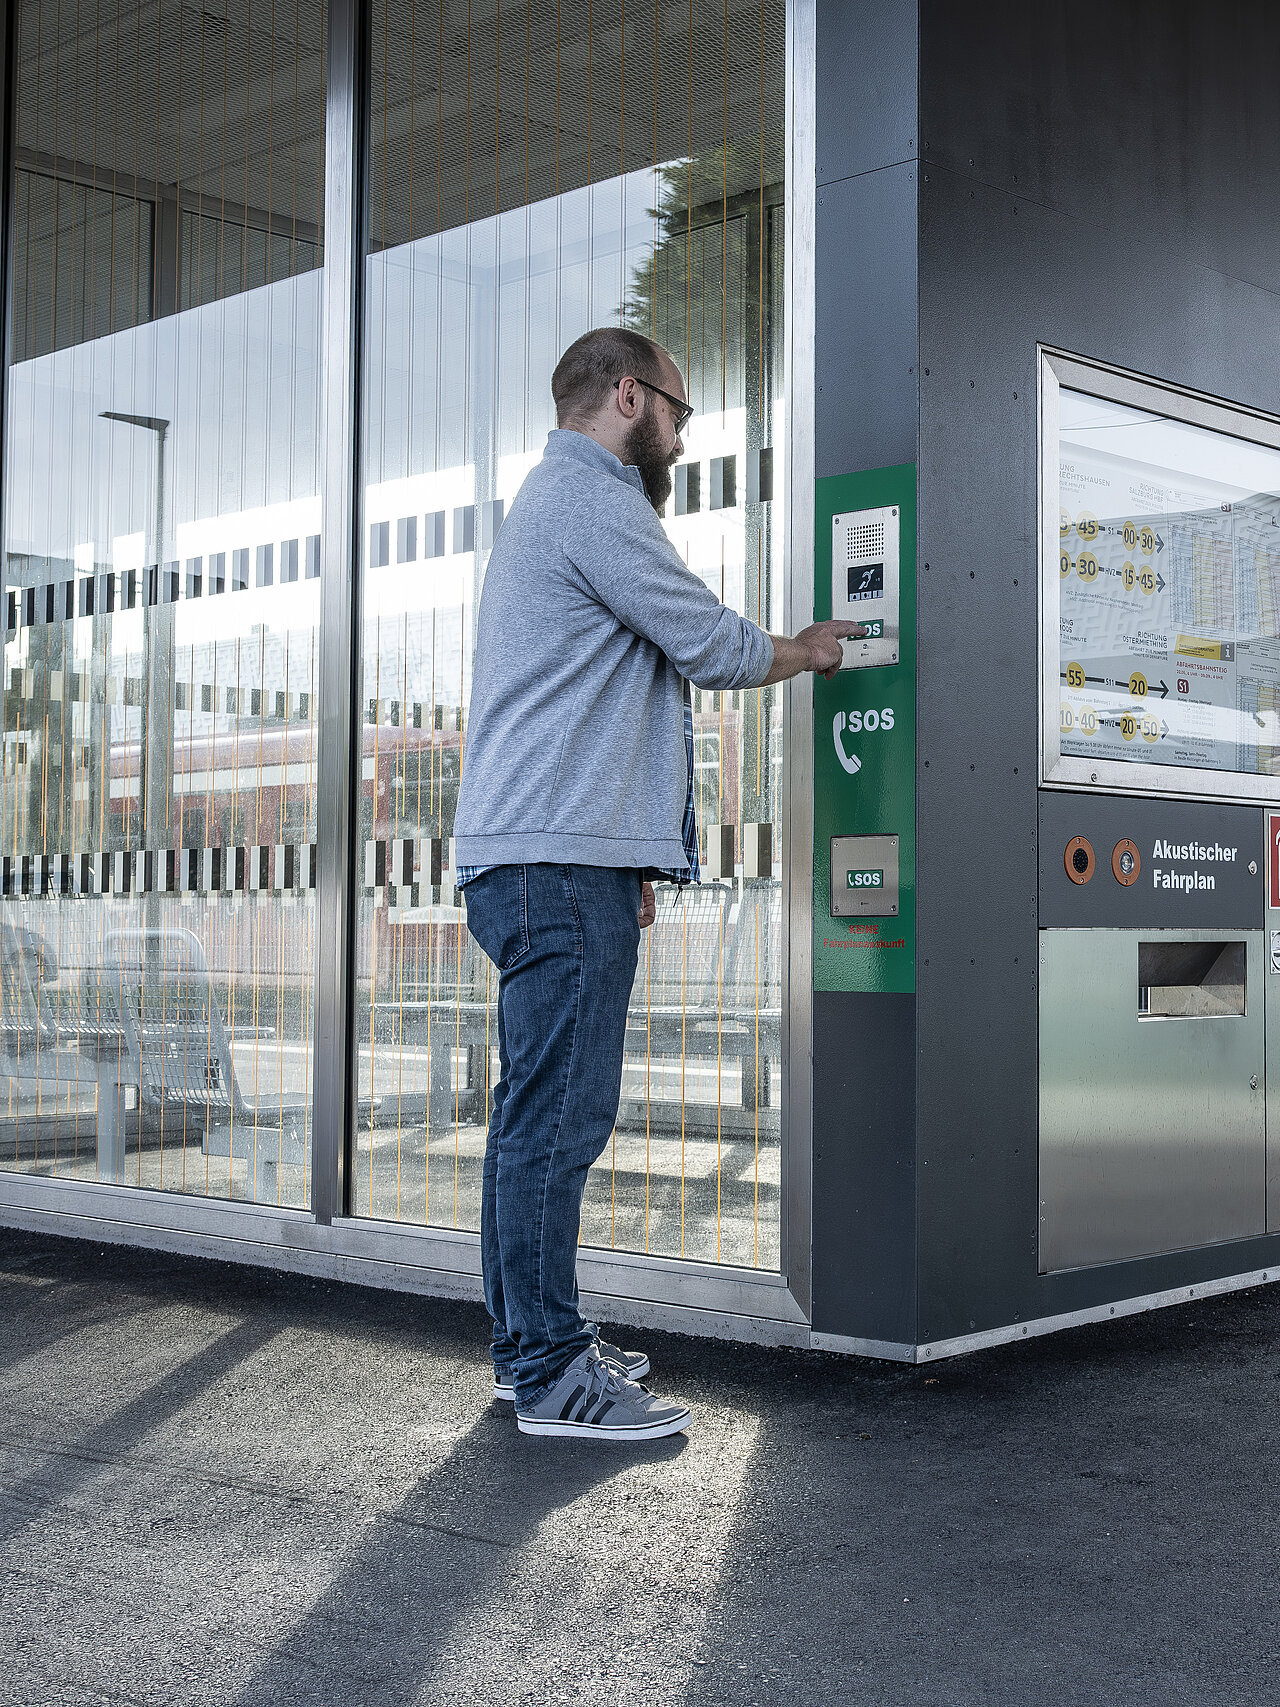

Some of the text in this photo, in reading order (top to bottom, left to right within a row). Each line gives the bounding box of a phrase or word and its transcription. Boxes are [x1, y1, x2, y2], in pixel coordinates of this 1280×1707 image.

[1078, 518, 1096, 535] 45
[1107, 526, 1115, 535] S1
[1123, 527, 1135, 545] 00
[1141, 532, 1153, 550] 30
[1078, 558, 1096, 576] 30
[1124, 568, 1134, 585] 15
[1140, 573, 1154, 590] 45
[1122, 635, 1168, 649] OSTERMIETHING
[1137, 630, 1168, 642] RICHTUNG
[1176, 661, 1228, 674] ABFAHRTSBAHNSTEIG
[1068, 670, 1146, 696] 55 S11 20
[1179, 680, 1187, 693] S1
[848, 708, 895, 733] SOS
[1060, 709, 1158, 737] 10 40 HVZ 20 50
[1152, 839, 1238, 862] Akustischer
[854, 872, 881, 886] SOS
[1153, 869, 1216, 893] Fahrplan
[848, 924, 879, 934] KEINE
[823, 938, 905, 950] Fahrplanauskunft
